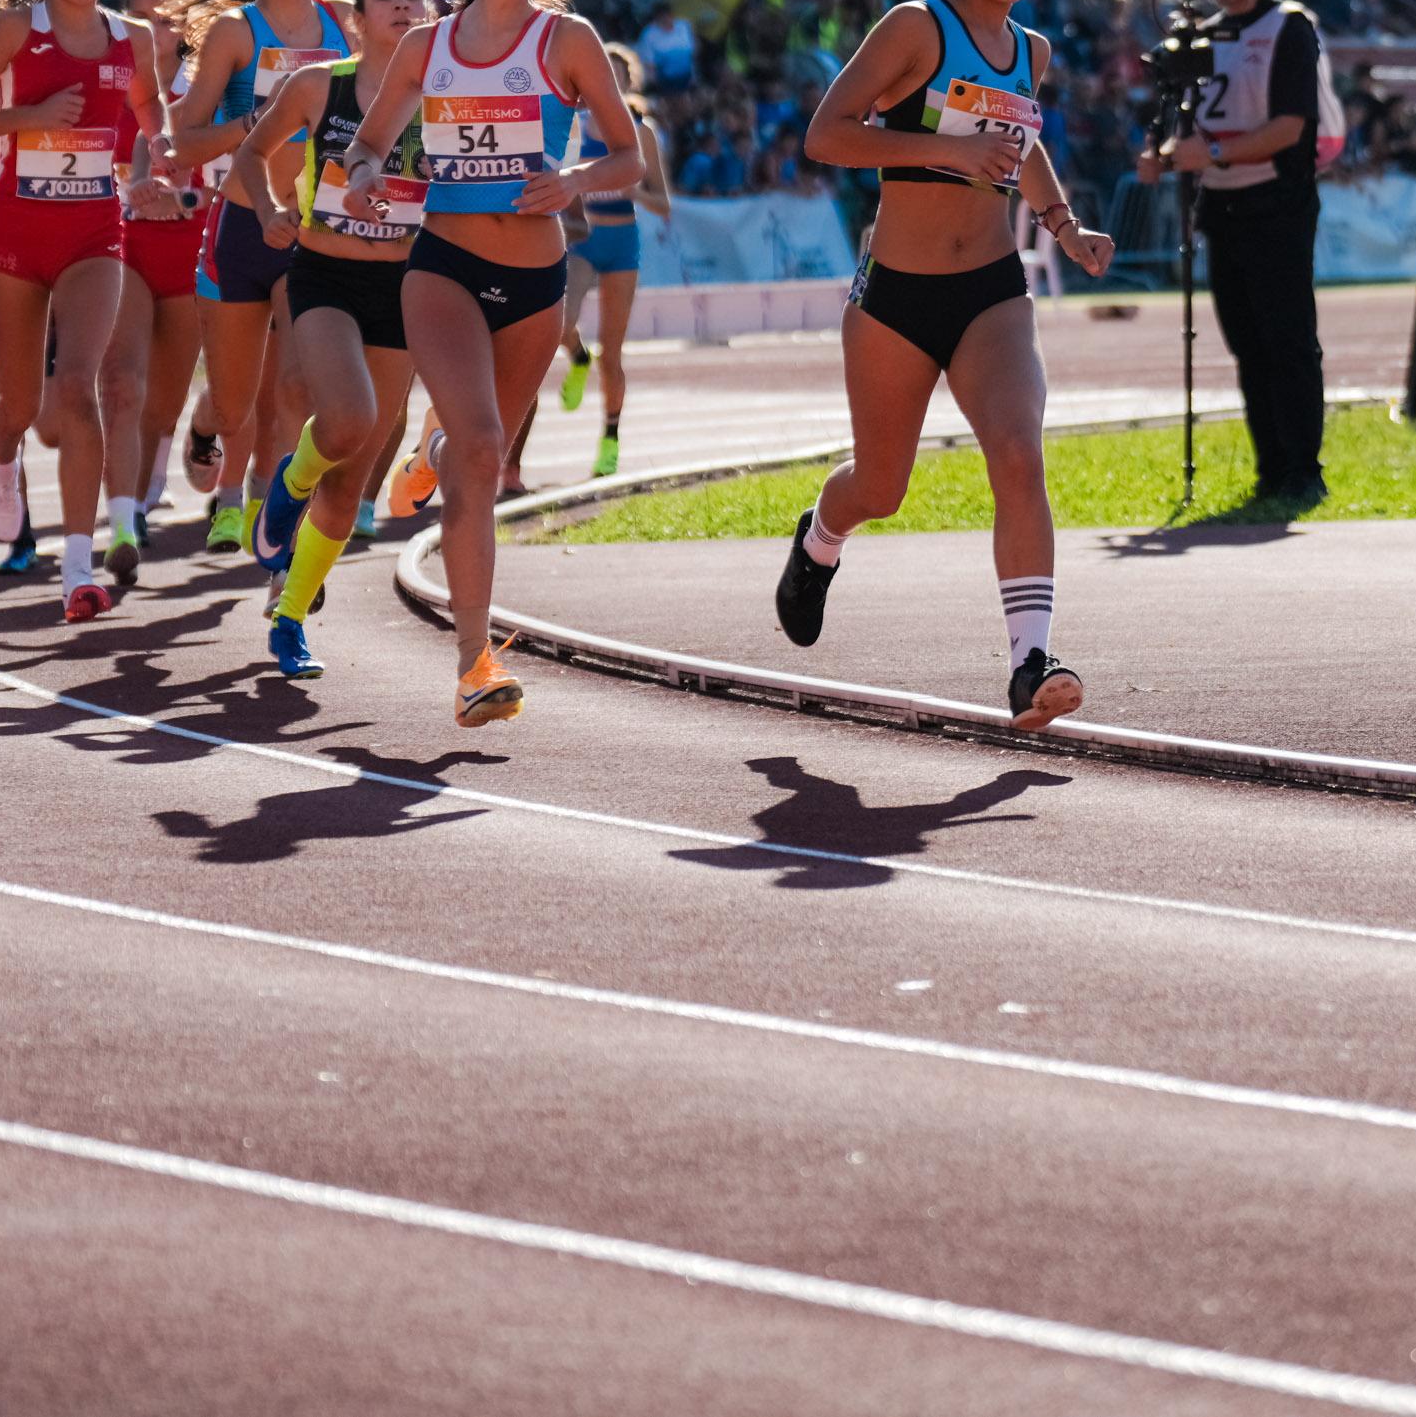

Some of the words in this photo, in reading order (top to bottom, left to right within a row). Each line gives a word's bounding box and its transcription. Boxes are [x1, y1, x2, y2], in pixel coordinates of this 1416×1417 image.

[456, 108, 522, 120] ATLETISMO
[988, 103, 1035, 123] ATLETISMO
[457, 124, 499, 154] 54
[60, 152, 77, 176] 2
[479, 291, 507, 303] amura
